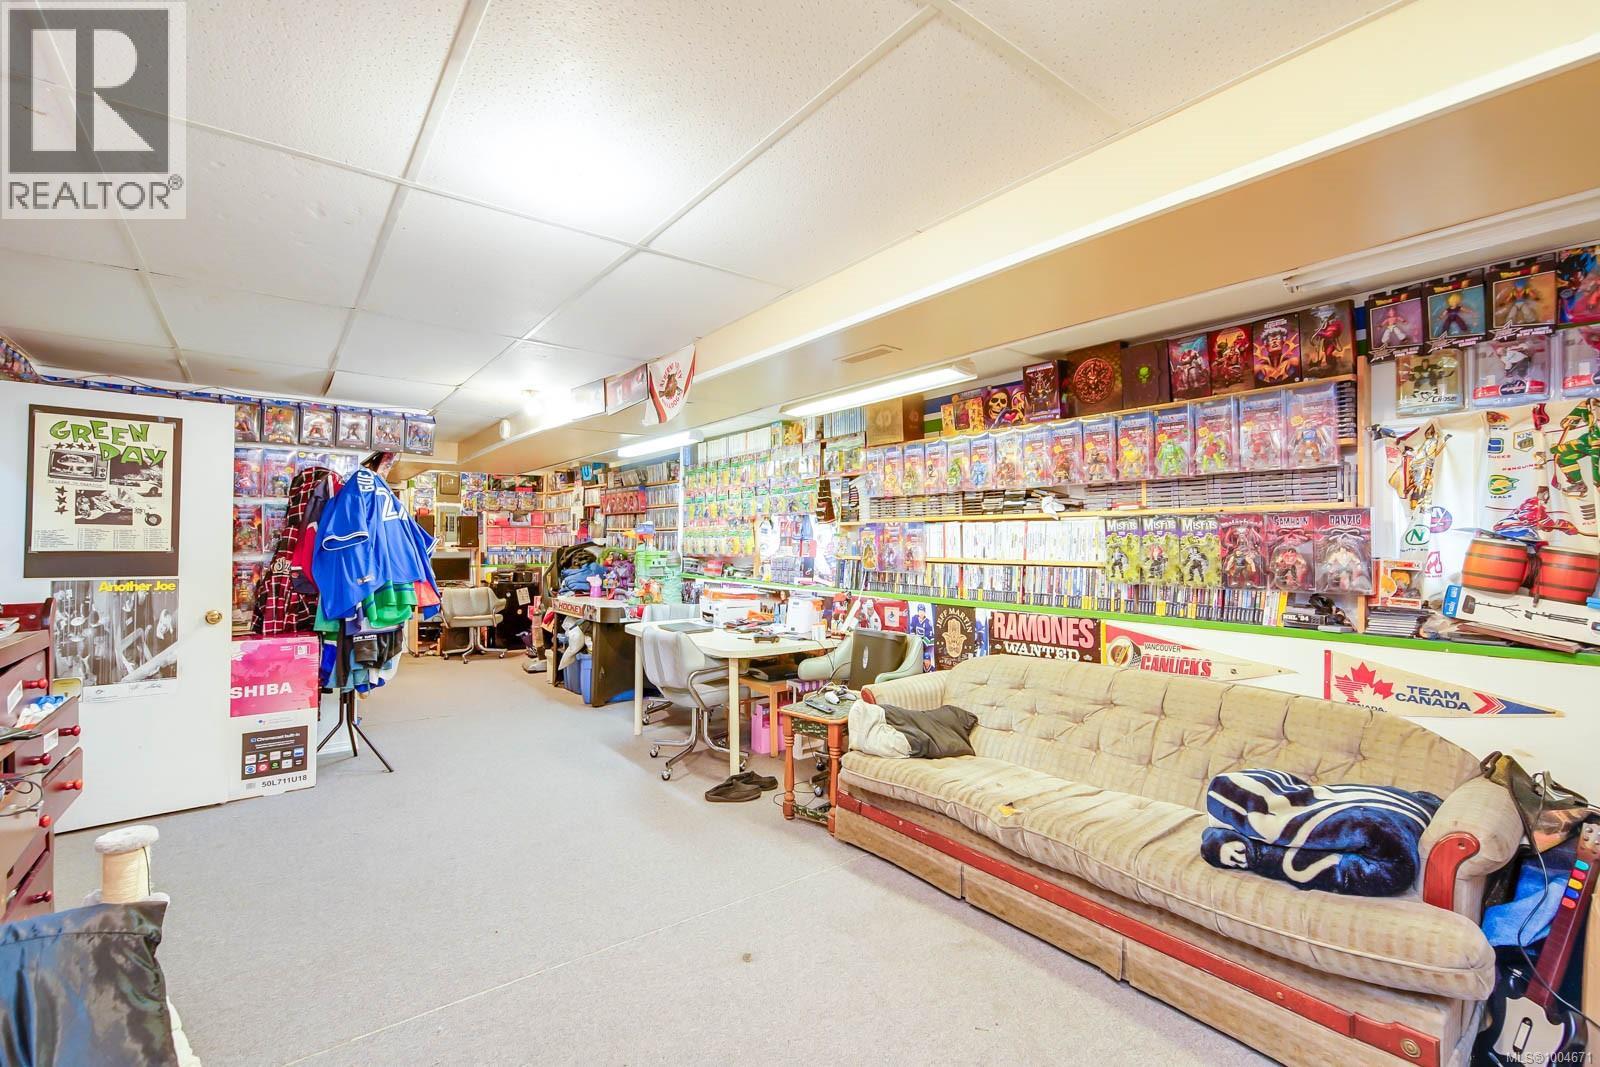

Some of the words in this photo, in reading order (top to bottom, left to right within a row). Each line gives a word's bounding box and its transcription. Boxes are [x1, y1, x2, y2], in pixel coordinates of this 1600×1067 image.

[49, 420, 150, 446] GREEN
[98, 442, 168, 466] DAY
[99, 581, 152, 593] Another
[154, 581, 177, 592] Joe
[936, 609, 948, 629] JEFF
[948, 607, 973, 633] MARTIN
[993, 612, 1095, 649] RAMONES
[1003, 640, 1080, 662] WANTED
[1144, 643, 1181, 653] VANCOUVER
[1140, 653, 1213, 677] CANUCKS
[1395, 693, 1471, 711] CANADA
[1406, 685, 1460, 701] TEAM
[261, 774, 308, 788] 50L711U18
